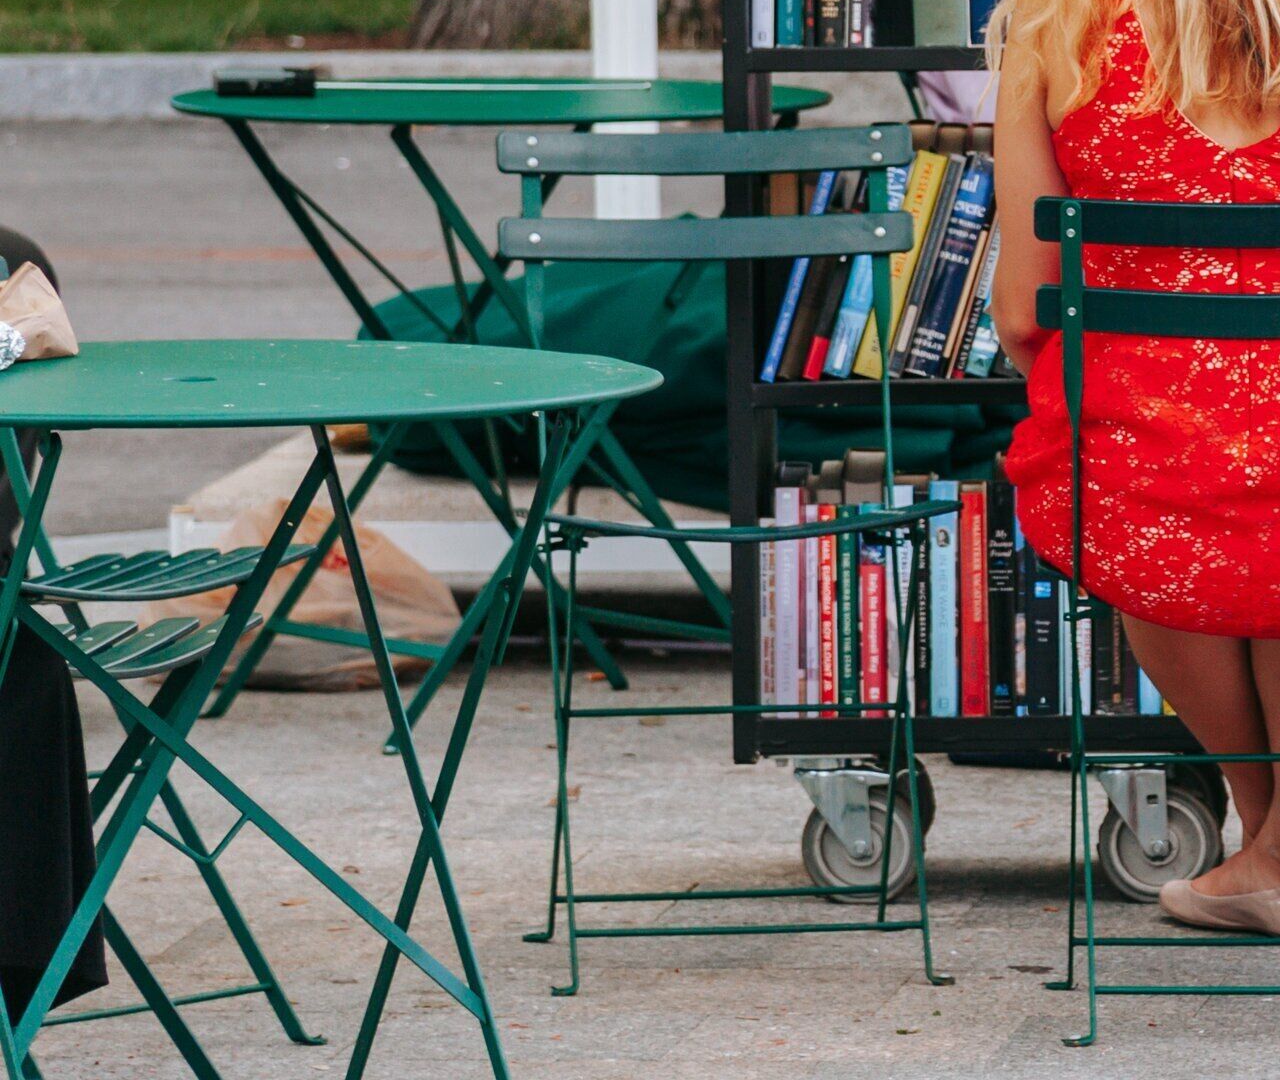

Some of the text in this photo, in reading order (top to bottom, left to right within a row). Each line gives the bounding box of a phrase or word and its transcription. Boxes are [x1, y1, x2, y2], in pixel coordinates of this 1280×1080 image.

[972, 514, 981, 621] VOLUNTEER VACATIONS
[918, 581, 926, 643] HUCKLEBERRY
[938, 596, 948, 627] WAKE
[822, 641, 833, 678] BLOUNT
[868, 655, 879, 673] Way
